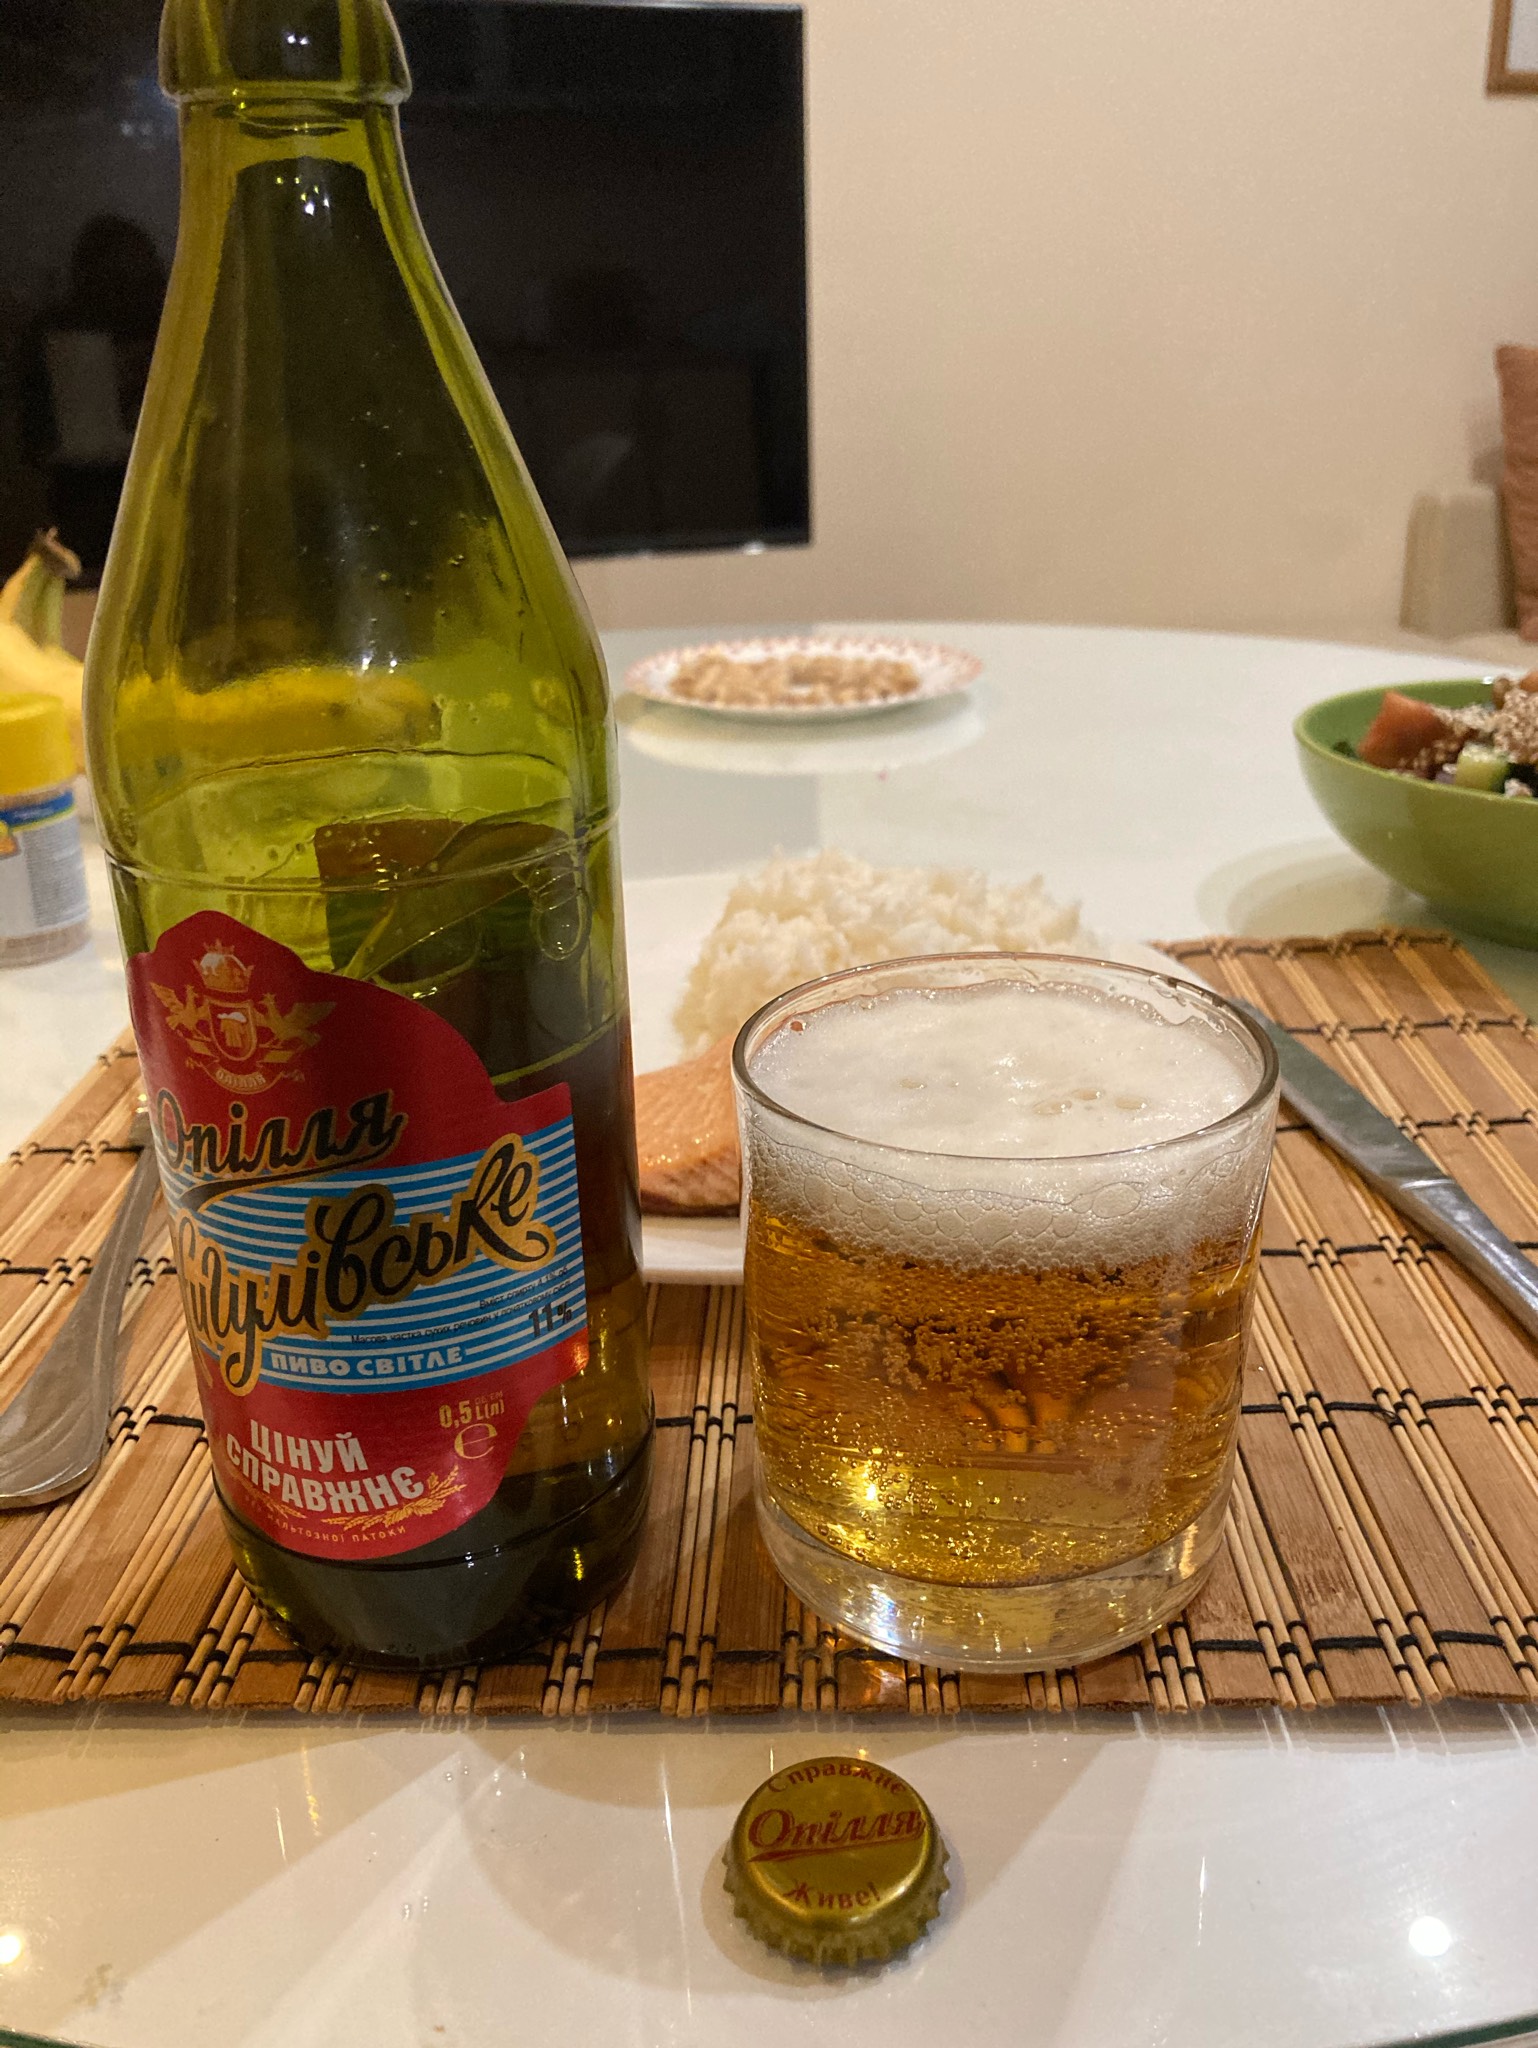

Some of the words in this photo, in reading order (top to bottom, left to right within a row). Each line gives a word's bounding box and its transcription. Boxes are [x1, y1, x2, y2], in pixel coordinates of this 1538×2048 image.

[156, 1087, 405, 1176] Опілля
[479, 1295, 505, 1311] Вміст
[528, 1301, 573, 1338] 11%
[351, 1333, 388, 1346] Масова
[389, 1329, 423, 1343] частка
[453, 1314, 493, 1334] речовин
[270, 1352, 351, 1377] ПИВО
[356, 1346, 464, 1377] СВІТЛЕ
[250, 1418, 368, 1474] ЦІНУЙ
[226, 1433, 425, 1514] СПРАВЖНЄ
[352, 1526, 407, 1543] ПАТОКИ
[747, 1808, 927, 1850] Опілля
